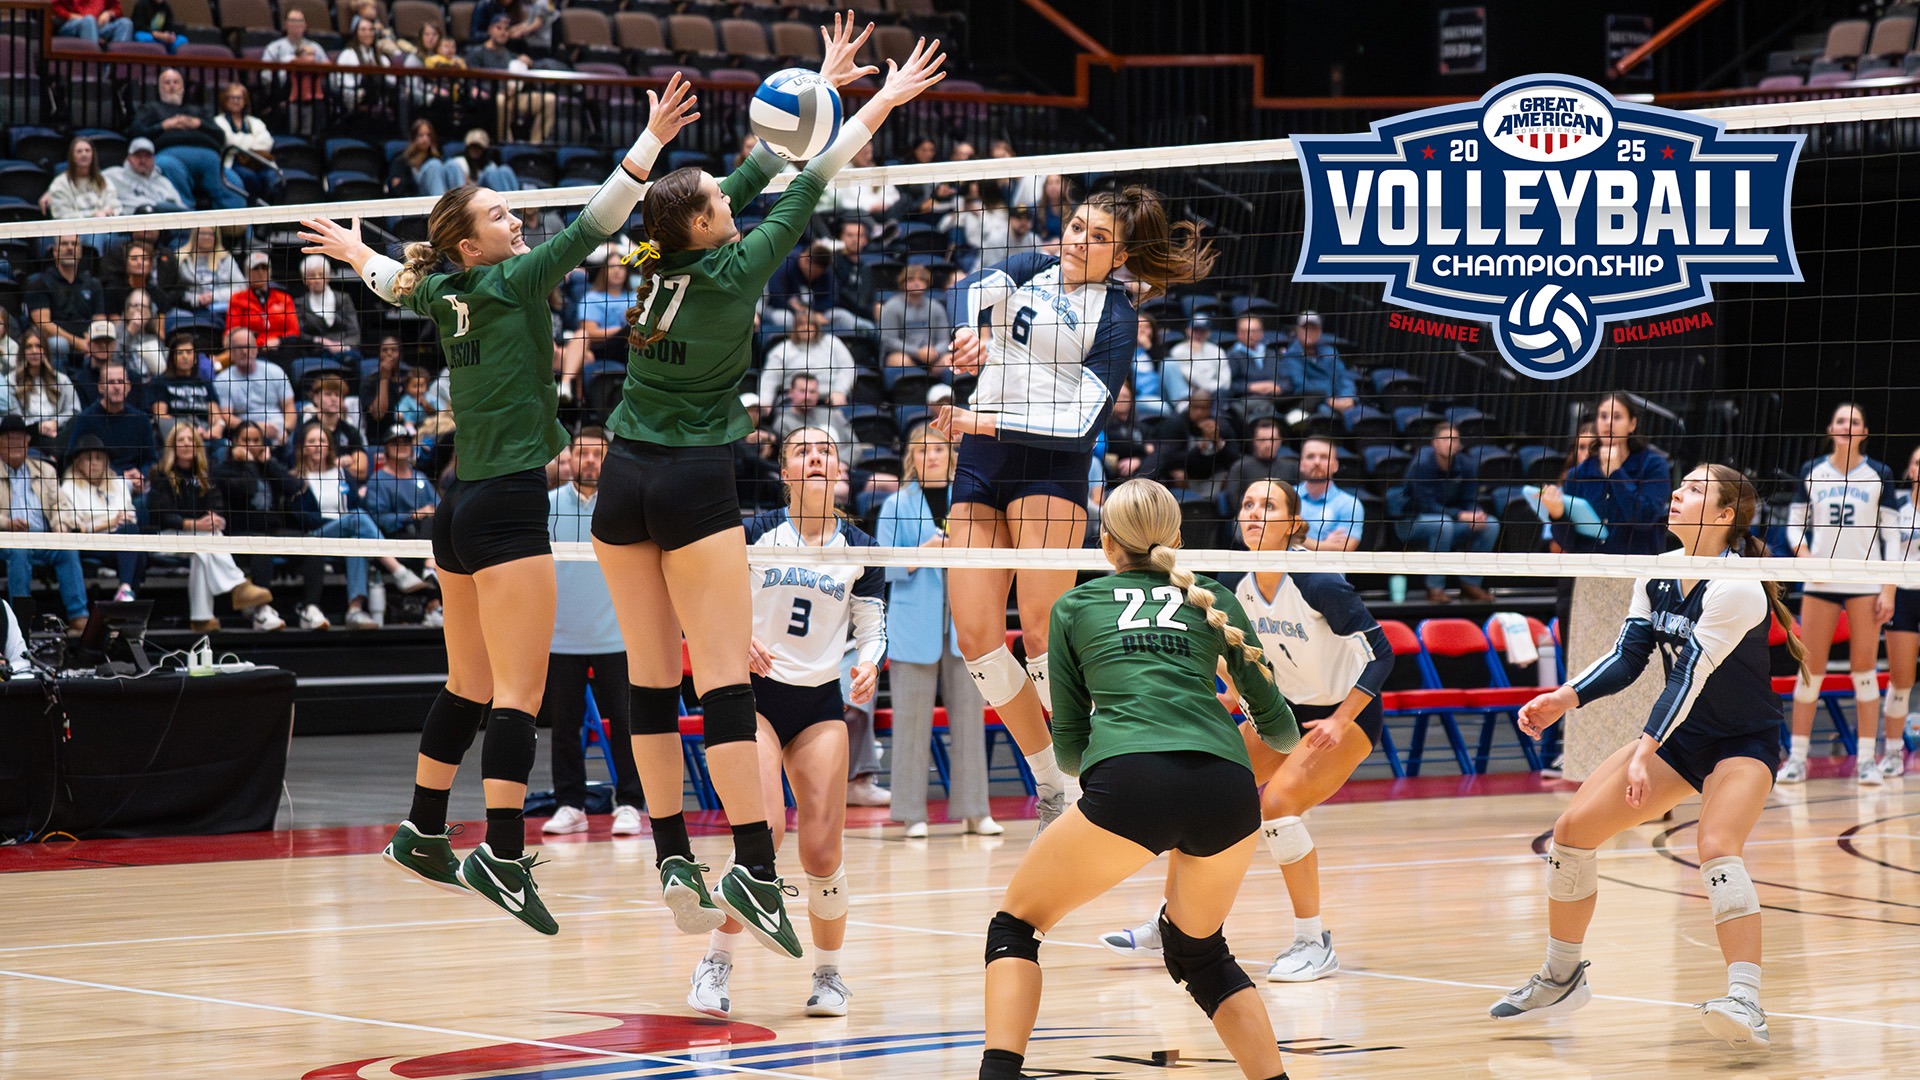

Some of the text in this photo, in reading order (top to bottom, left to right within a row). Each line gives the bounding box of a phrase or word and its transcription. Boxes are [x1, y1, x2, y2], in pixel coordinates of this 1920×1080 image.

[1012, 305, 1039, 345] 6
[631, 337, 688, 366] SON
[1829, 503, 1856, 525] 32
[762, 566, 846, 602] DAWGS
[786, 597, 812, 638] 3
[1113, 585, 1189, 632] 22
[1121, 632, 1192, 658] BISON
